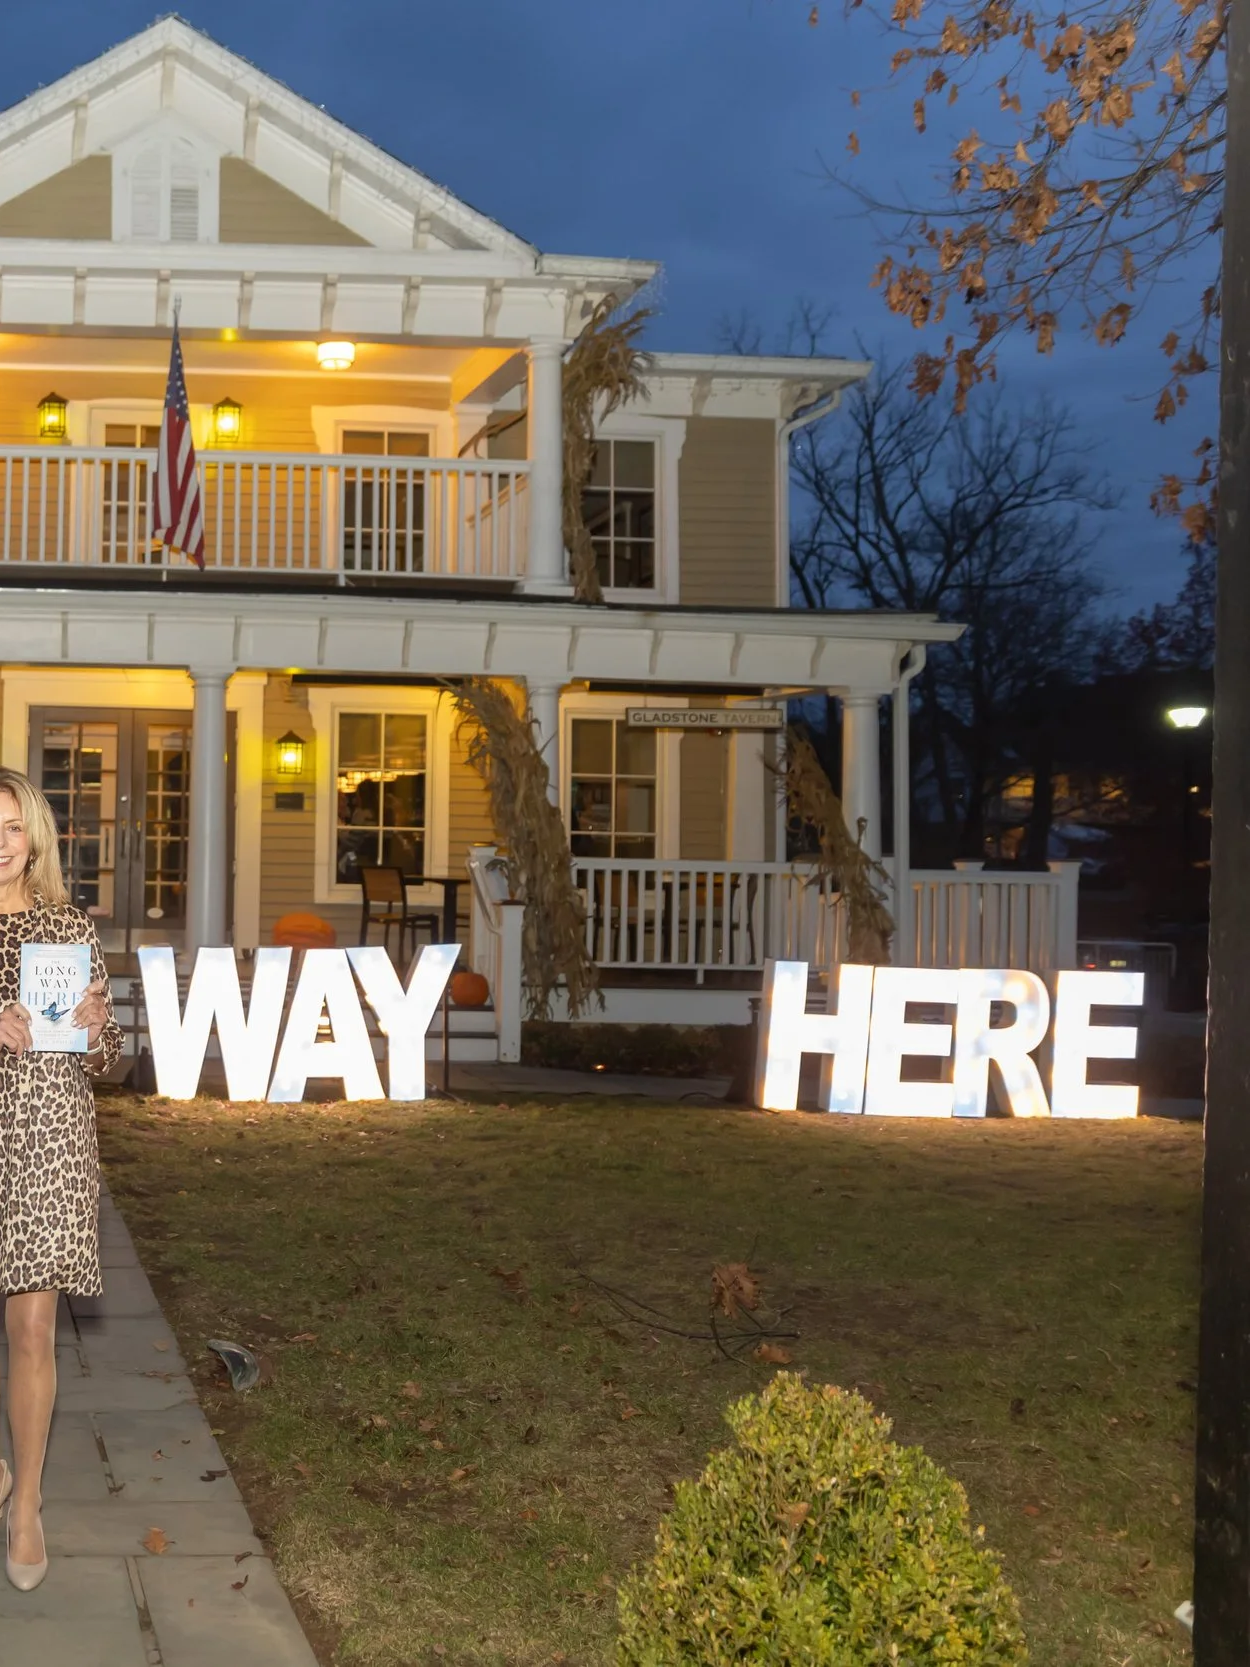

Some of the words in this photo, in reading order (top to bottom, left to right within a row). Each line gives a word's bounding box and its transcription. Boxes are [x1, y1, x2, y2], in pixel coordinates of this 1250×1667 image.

[632, 712, 719, 724] GLADSTONE
[723, 713, 778, 724] TAVERN
[35, 965, 77, 976] LONG
[39, 978, 71, 989] WAY
[137, 943, 463, 1103] WAY
[758, 959, 1145, 1119] HERE
